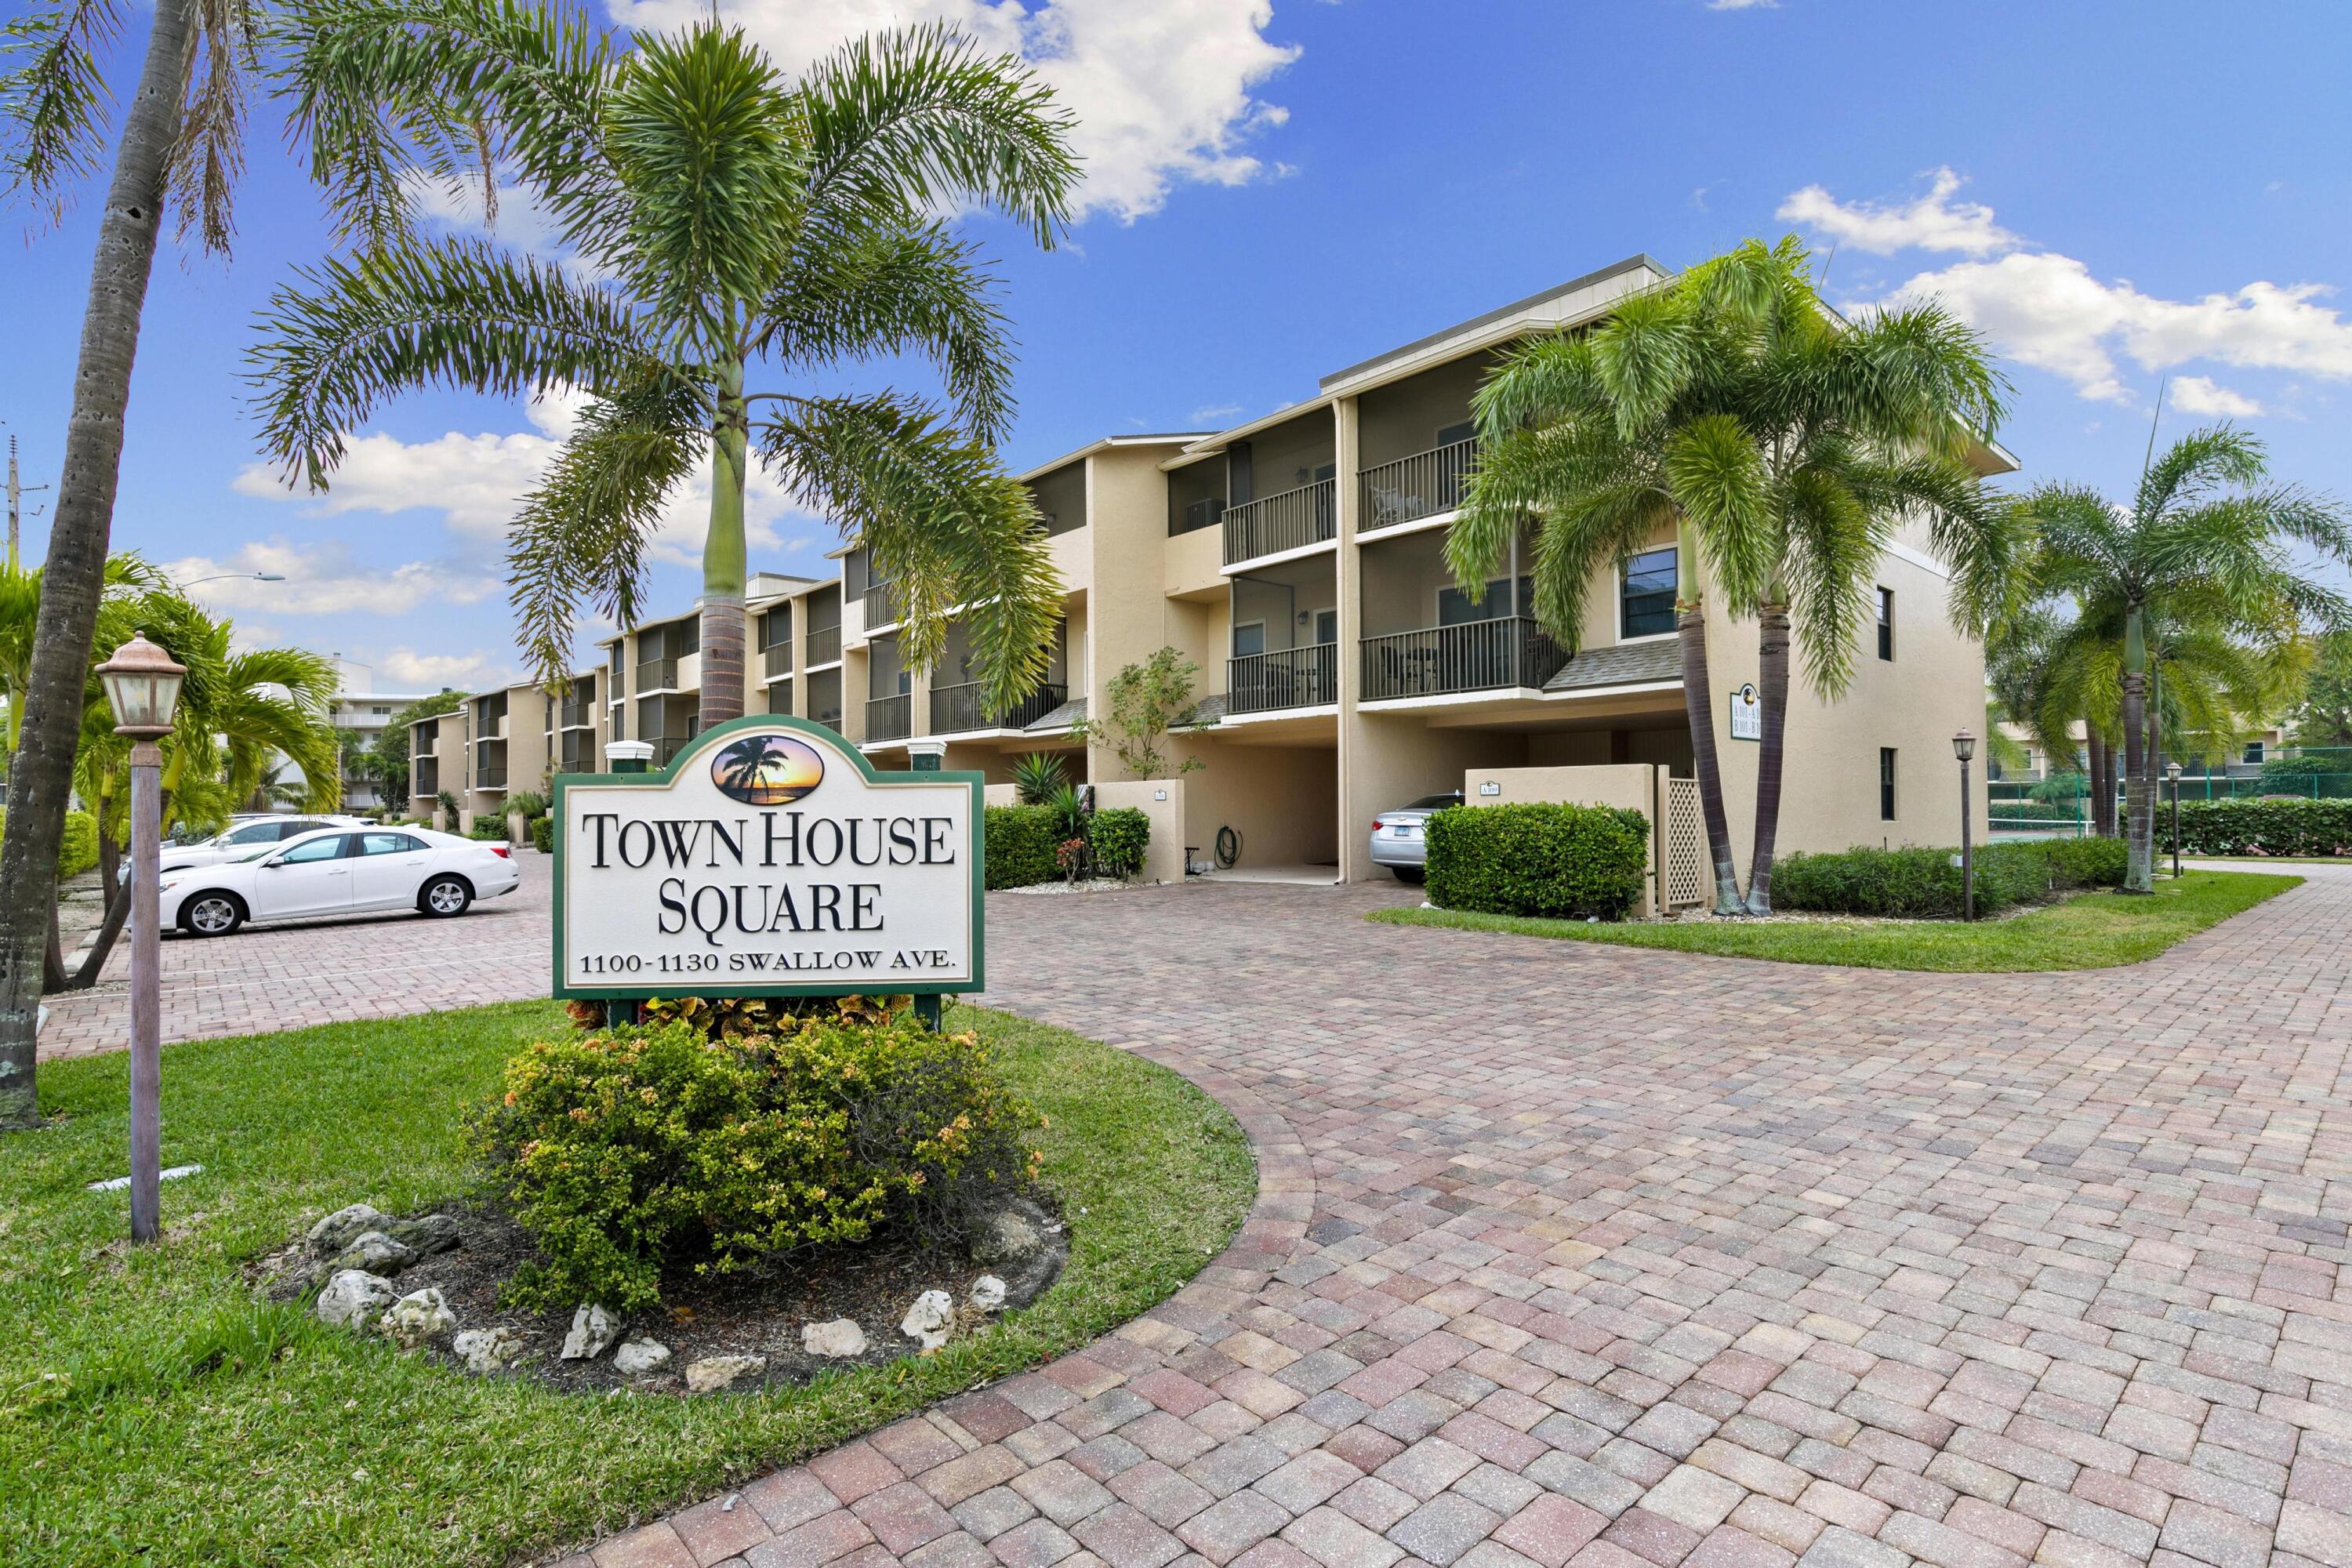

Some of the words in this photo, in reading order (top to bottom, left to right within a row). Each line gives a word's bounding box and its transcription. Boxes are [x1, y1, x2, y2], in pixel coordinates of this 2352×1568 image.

[582, 813, 749, 869] TOWN
[759, 811, 955, 867] HOUSE
[659, 877, 884, 947] SQUARE
[581, 953, 719, 973] 1100-1130
[729, 951, 883, 971] SWALLOW
[890, 949, 956, 971] AVE.
